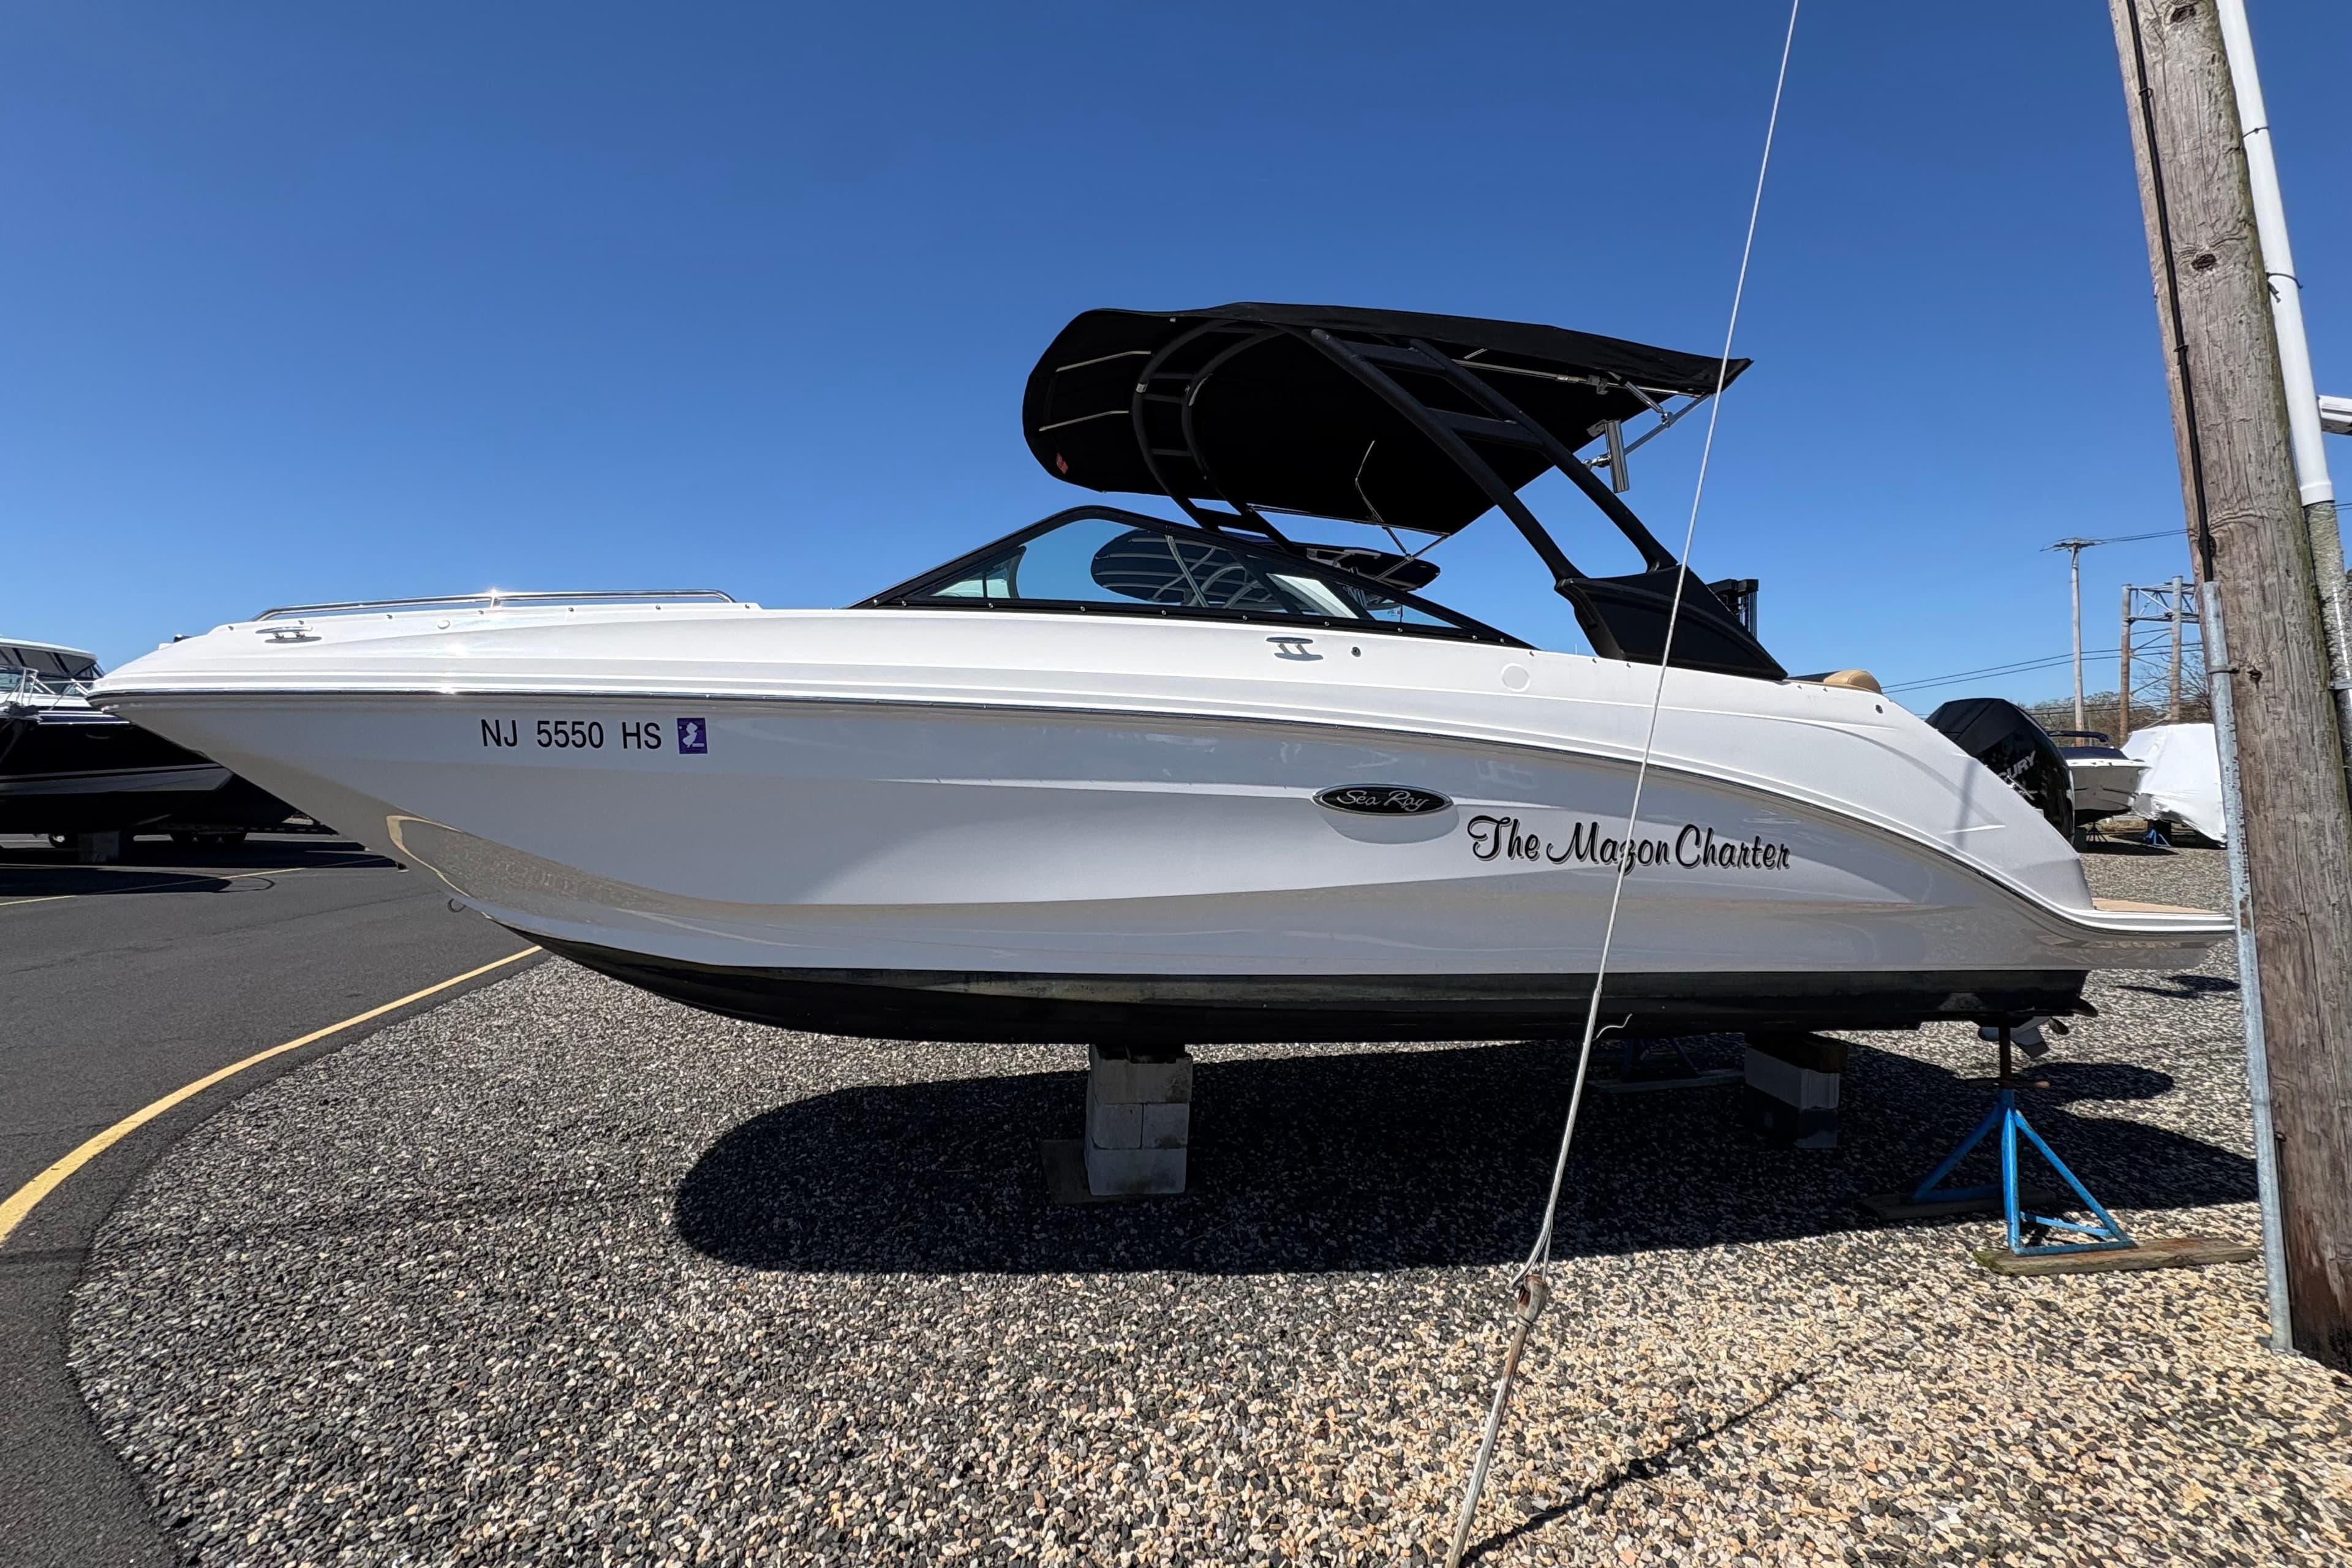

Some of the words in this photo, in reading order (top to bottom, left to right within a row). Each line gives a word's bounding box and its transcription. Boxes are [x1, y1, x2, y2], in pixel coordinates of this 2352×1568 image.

[481, 718, 518, 747] NJ
[537, 720, 604, 749] 5550
[622, 722, 662, 750] HS
[1336, 790, 1382, 806] Sea
[1383, 790, 1430, 812] Ray
[1468, 815, 1540, 861] The
[1675, 823, 1793, 871] Charter
